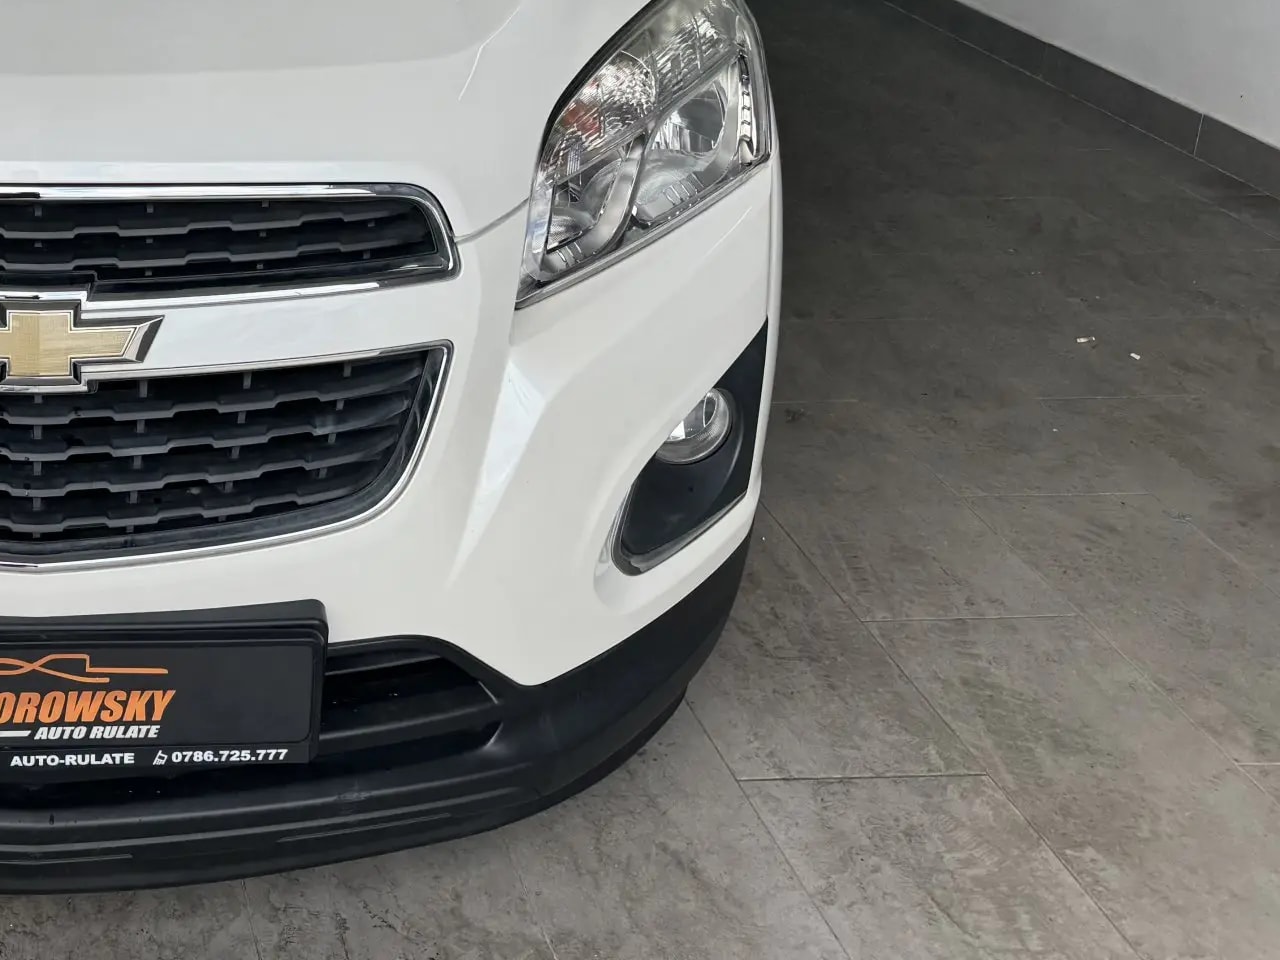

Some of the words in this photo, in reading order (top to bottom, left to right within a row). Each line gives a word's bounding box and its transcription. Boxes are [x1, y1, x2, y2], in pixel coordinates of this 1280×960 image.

[34, 726, 86, 740] AUTO
[89, 725, 161, 739] RULATE
[10, 752, 135, 767] AUTO-RULATE
[171, 748, 288, 763] 0786.725.777
